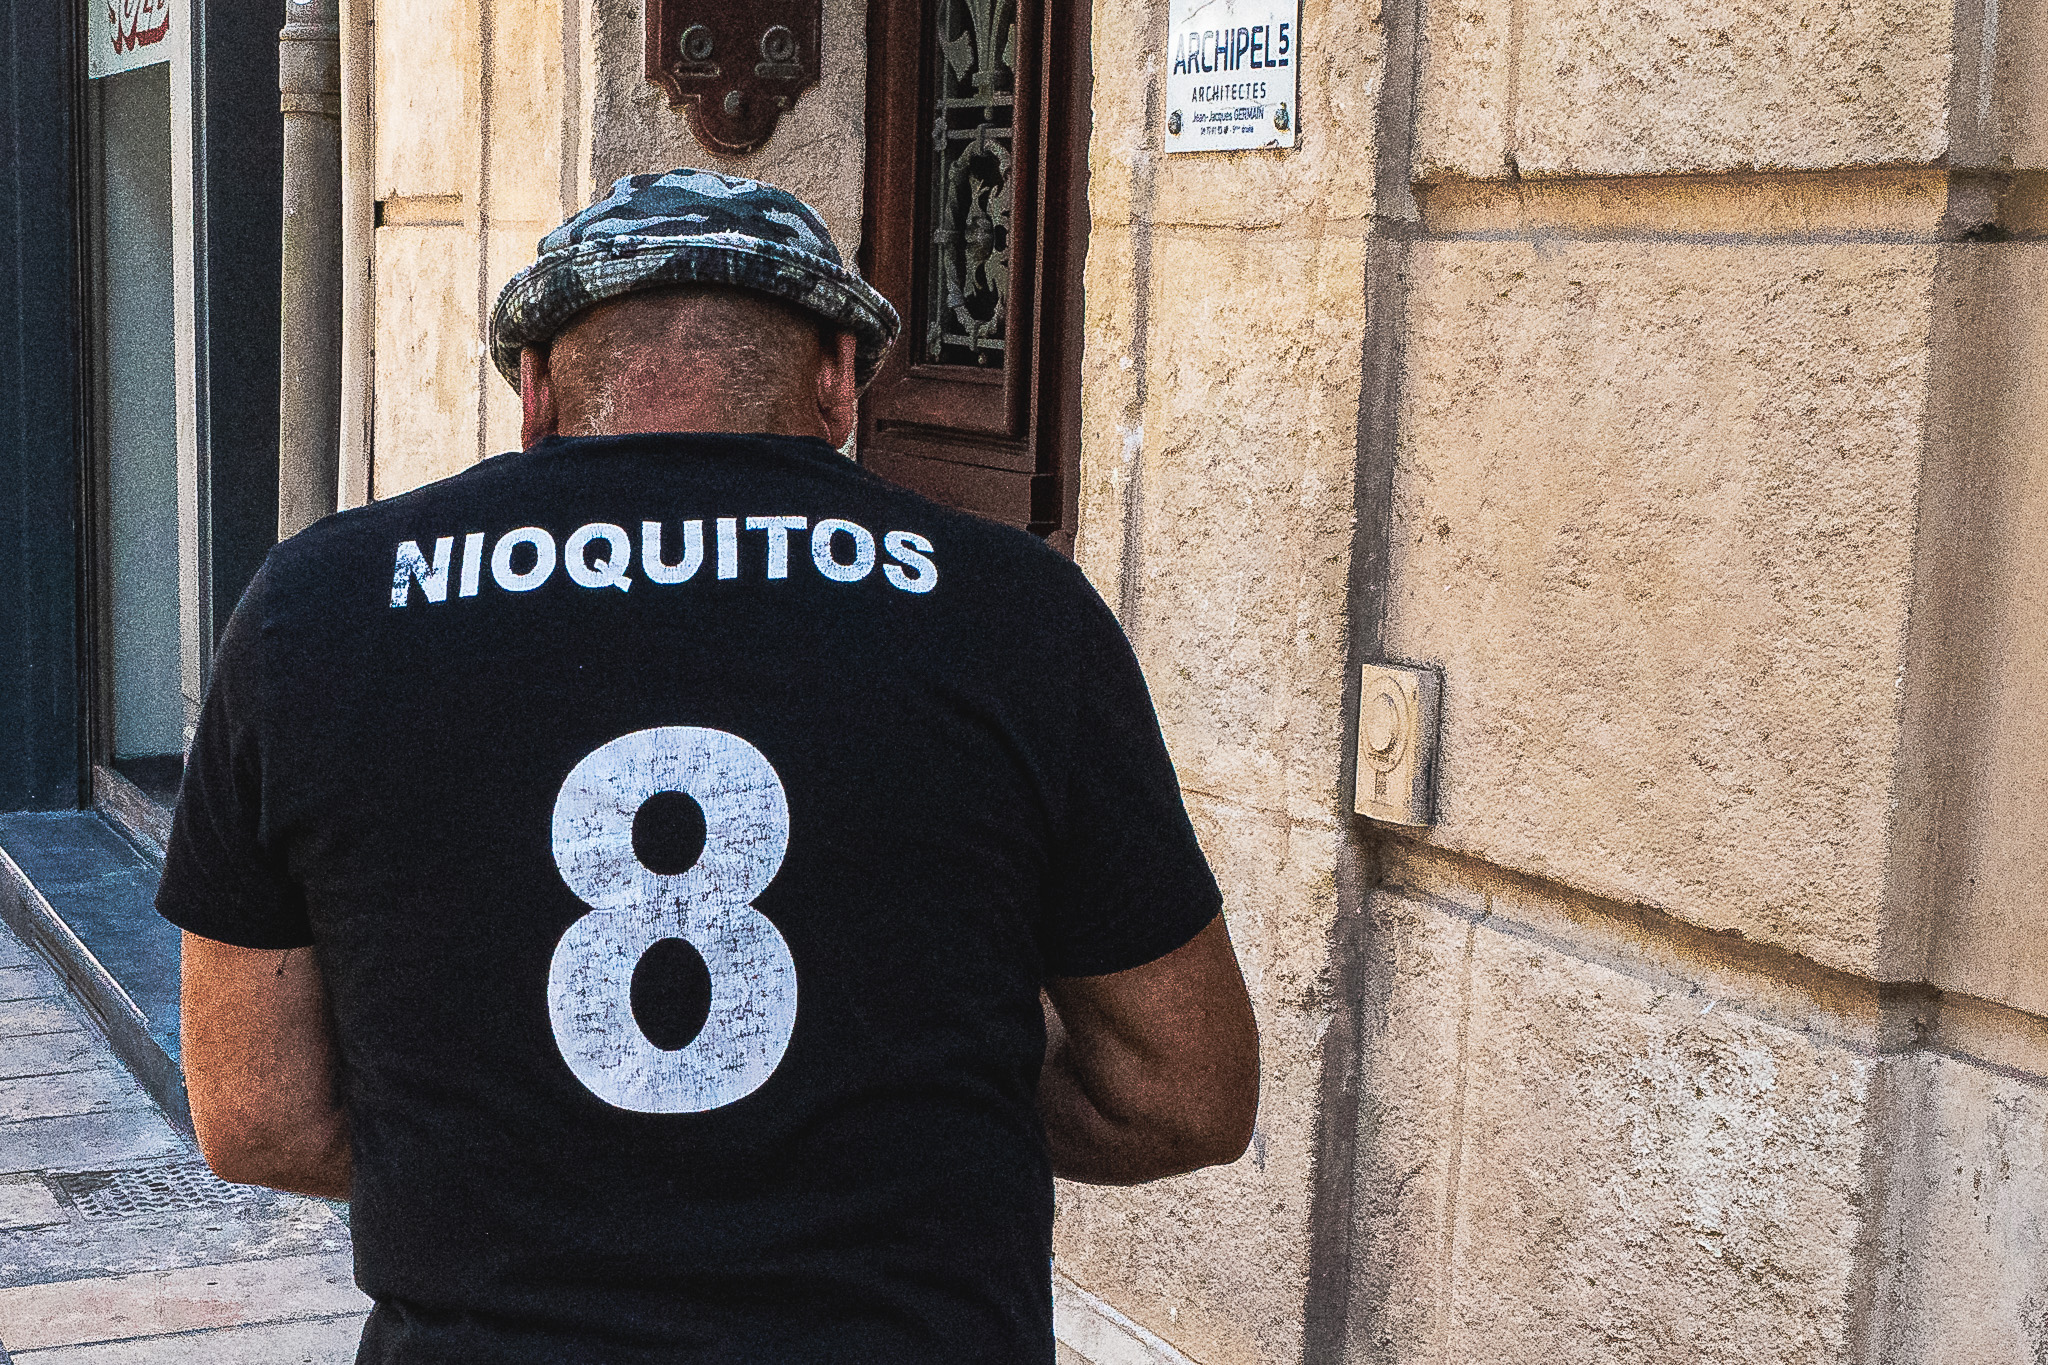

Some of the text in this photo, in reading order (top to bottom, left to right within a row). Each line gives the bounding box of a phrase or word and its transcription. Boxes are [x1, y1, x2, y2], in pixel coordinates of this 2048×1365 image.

[1191, 82, 1266, 102] ARCHITECTES
[1233, 106, 1264, 121] GERMAIN
[389, 516, 938, 608] NIOQUITOS
[547, 726, 797, 1113] 8
